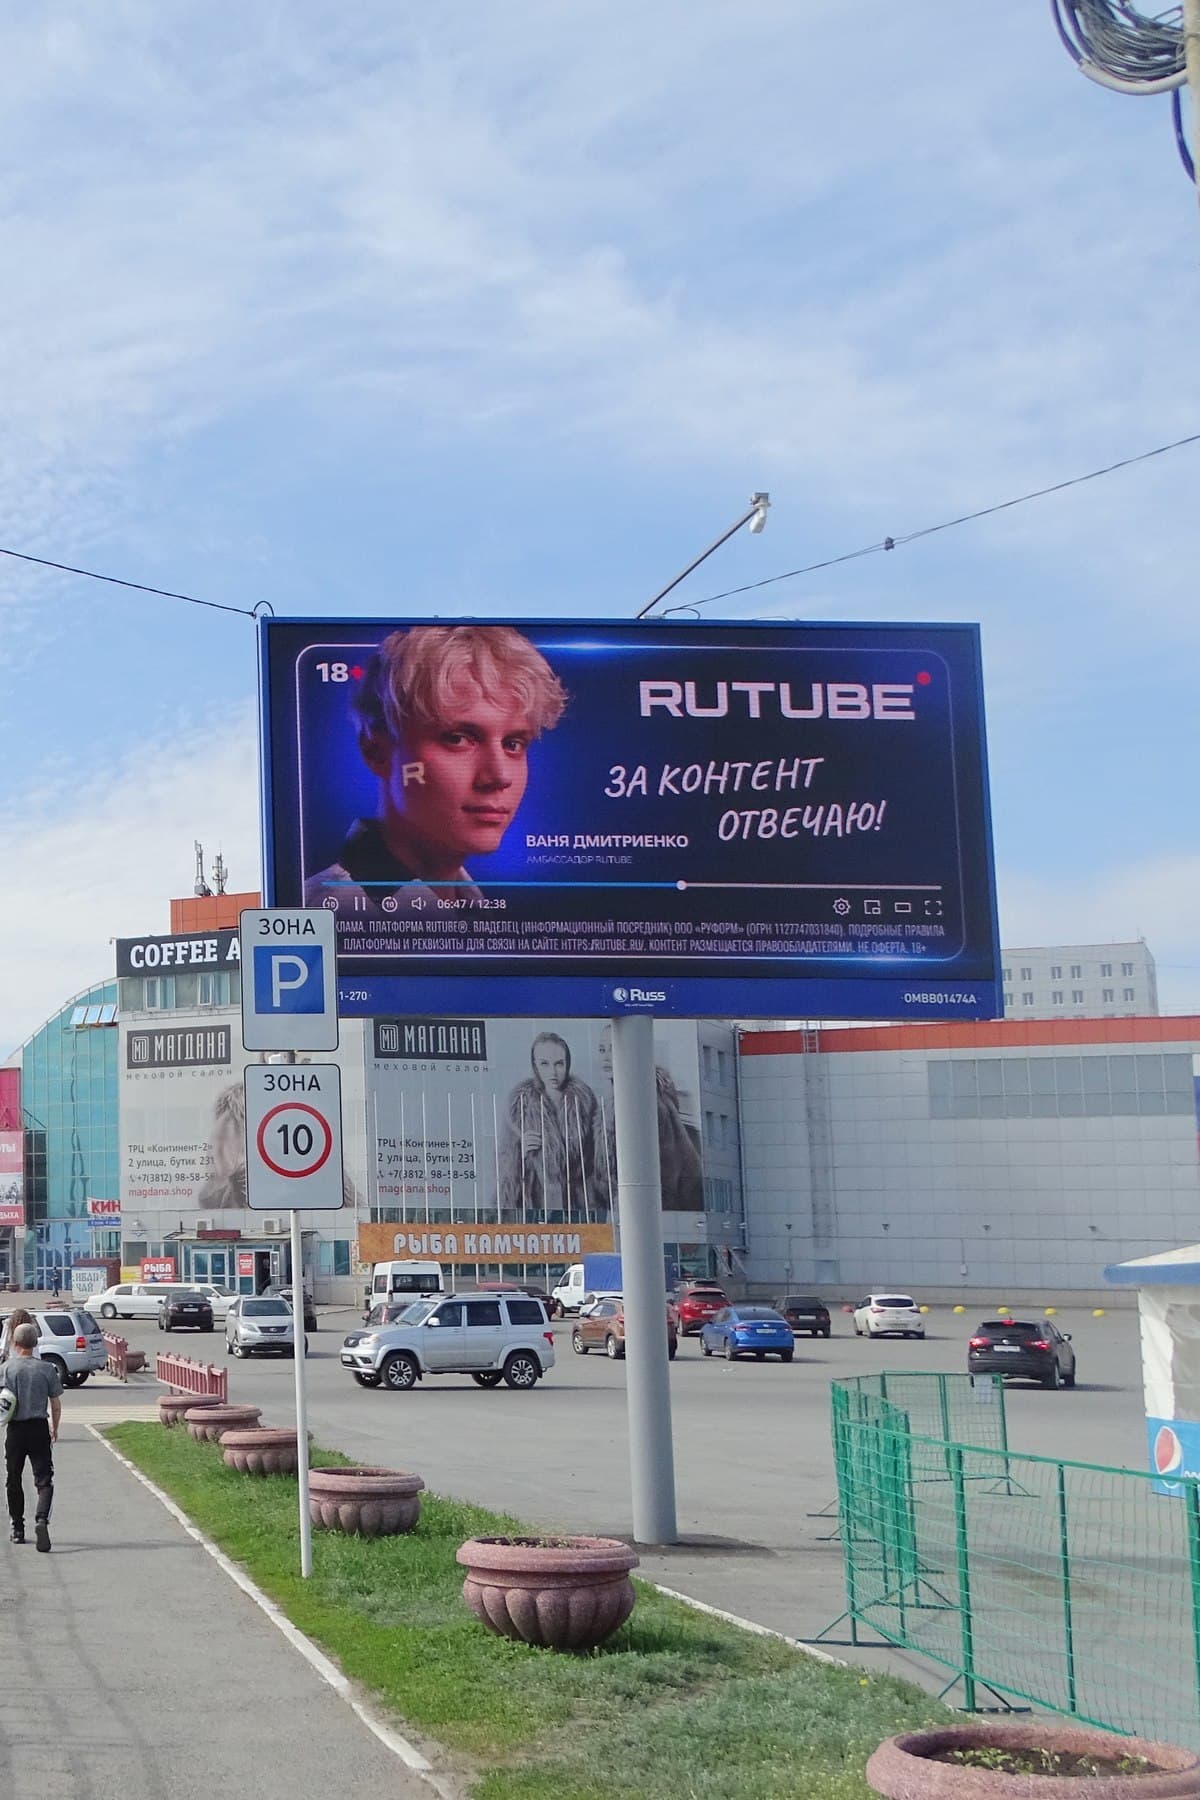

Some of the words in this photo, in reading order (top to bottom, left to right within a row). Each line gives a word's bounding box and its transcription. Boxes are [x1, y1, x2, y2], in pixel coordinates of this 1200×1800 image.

[316, 663, 365, 682] 18+
[639, 681, 916, 722] RUTUBE
[402, 761, 426, 787] R
[604, 765, 648, 798] ЗА
[658, 757, 825, 796] КОНТЕНТ
[718, 799, 887, 841] ОТВЕЧАЮ!
[526, 835, 569, 848] ВАНЯ
[573, 835, 689, 849] ДМИТРИЕНКО
[526, 855, 593, 865] АМБАССАДОР
[596, 855, 633, 864] RUTUBE
[437, 899, 467, 909] 06:47
[478, 899, 507, 909] 12:38
[259, 919, 316, 936] ЗОНА
[369, 921, 424, 934] ПЛАТФОРМА
[474, 921, 520, 935] ВЛАДЕЛЕЦ
[521, 920, 615, 935] (ИНФОРМАЦИОННЫЙ
[617, 922, 672, 936] ПОСРЕДНИК)
[674, 922, 692, 934] ООО
[849, 924, 903, 937] ПОДРОБНЫЕ
[905, 925, 945, 936] ПРАВИЛА
[130, 938, 218, 968] COFFEE
[344, 938, 401, 951] ПЛАТФОРМЫ
[403, 938, 410, 950] И
[412, 938, 464, 950] РЕКВИЗИТЫ
[466, 939, 484, 952] ДЛЯ
[487, 938, 517, 951] СВЯЗИ
[518, 939, 530, 950] НА
[532, 937, 558, 950] САЙТЕ
[650, 940, 688, 951] КОНТЕНТ
[858, 942, 869, 953] НЕ
[271, 955, 309, 1007] P
[630, 988, 666, 1001] Russ
[154, 1031, 226, 1061] МАГДАНА
[404, 1025, 481, 1054] МАГДАНА
[126, 1069, 183, 1080] меховой
[192, 1068, 232, 1078] салон
[374, 1063, 436, 1072] меховой
[446, 1064, 489, 1072] салон
[263, 1074, 321, 1092] ЗОНА
[276, 1124, 313, 1155] 10
[377, 1138, 396, 1148] ТРЦ
[128, 1144, 144, 1153] ТРЦ
[128, 1158, 134, 1167] 2
[137, 1159, 167, 1169] улица,
[170, 1156, 196, 1168] бутик
[377, 1153, 383, 1162] 2
[128, 1186, 193, 1198] magdana.shop
[91, 1200, 120, 1214] КИН
[393, 1232, 458, 1255] РЫБА
[464, 1232, 582, 1255] КАМЧАТКИ
[144, 1263, 172, 1273] РЫБА
